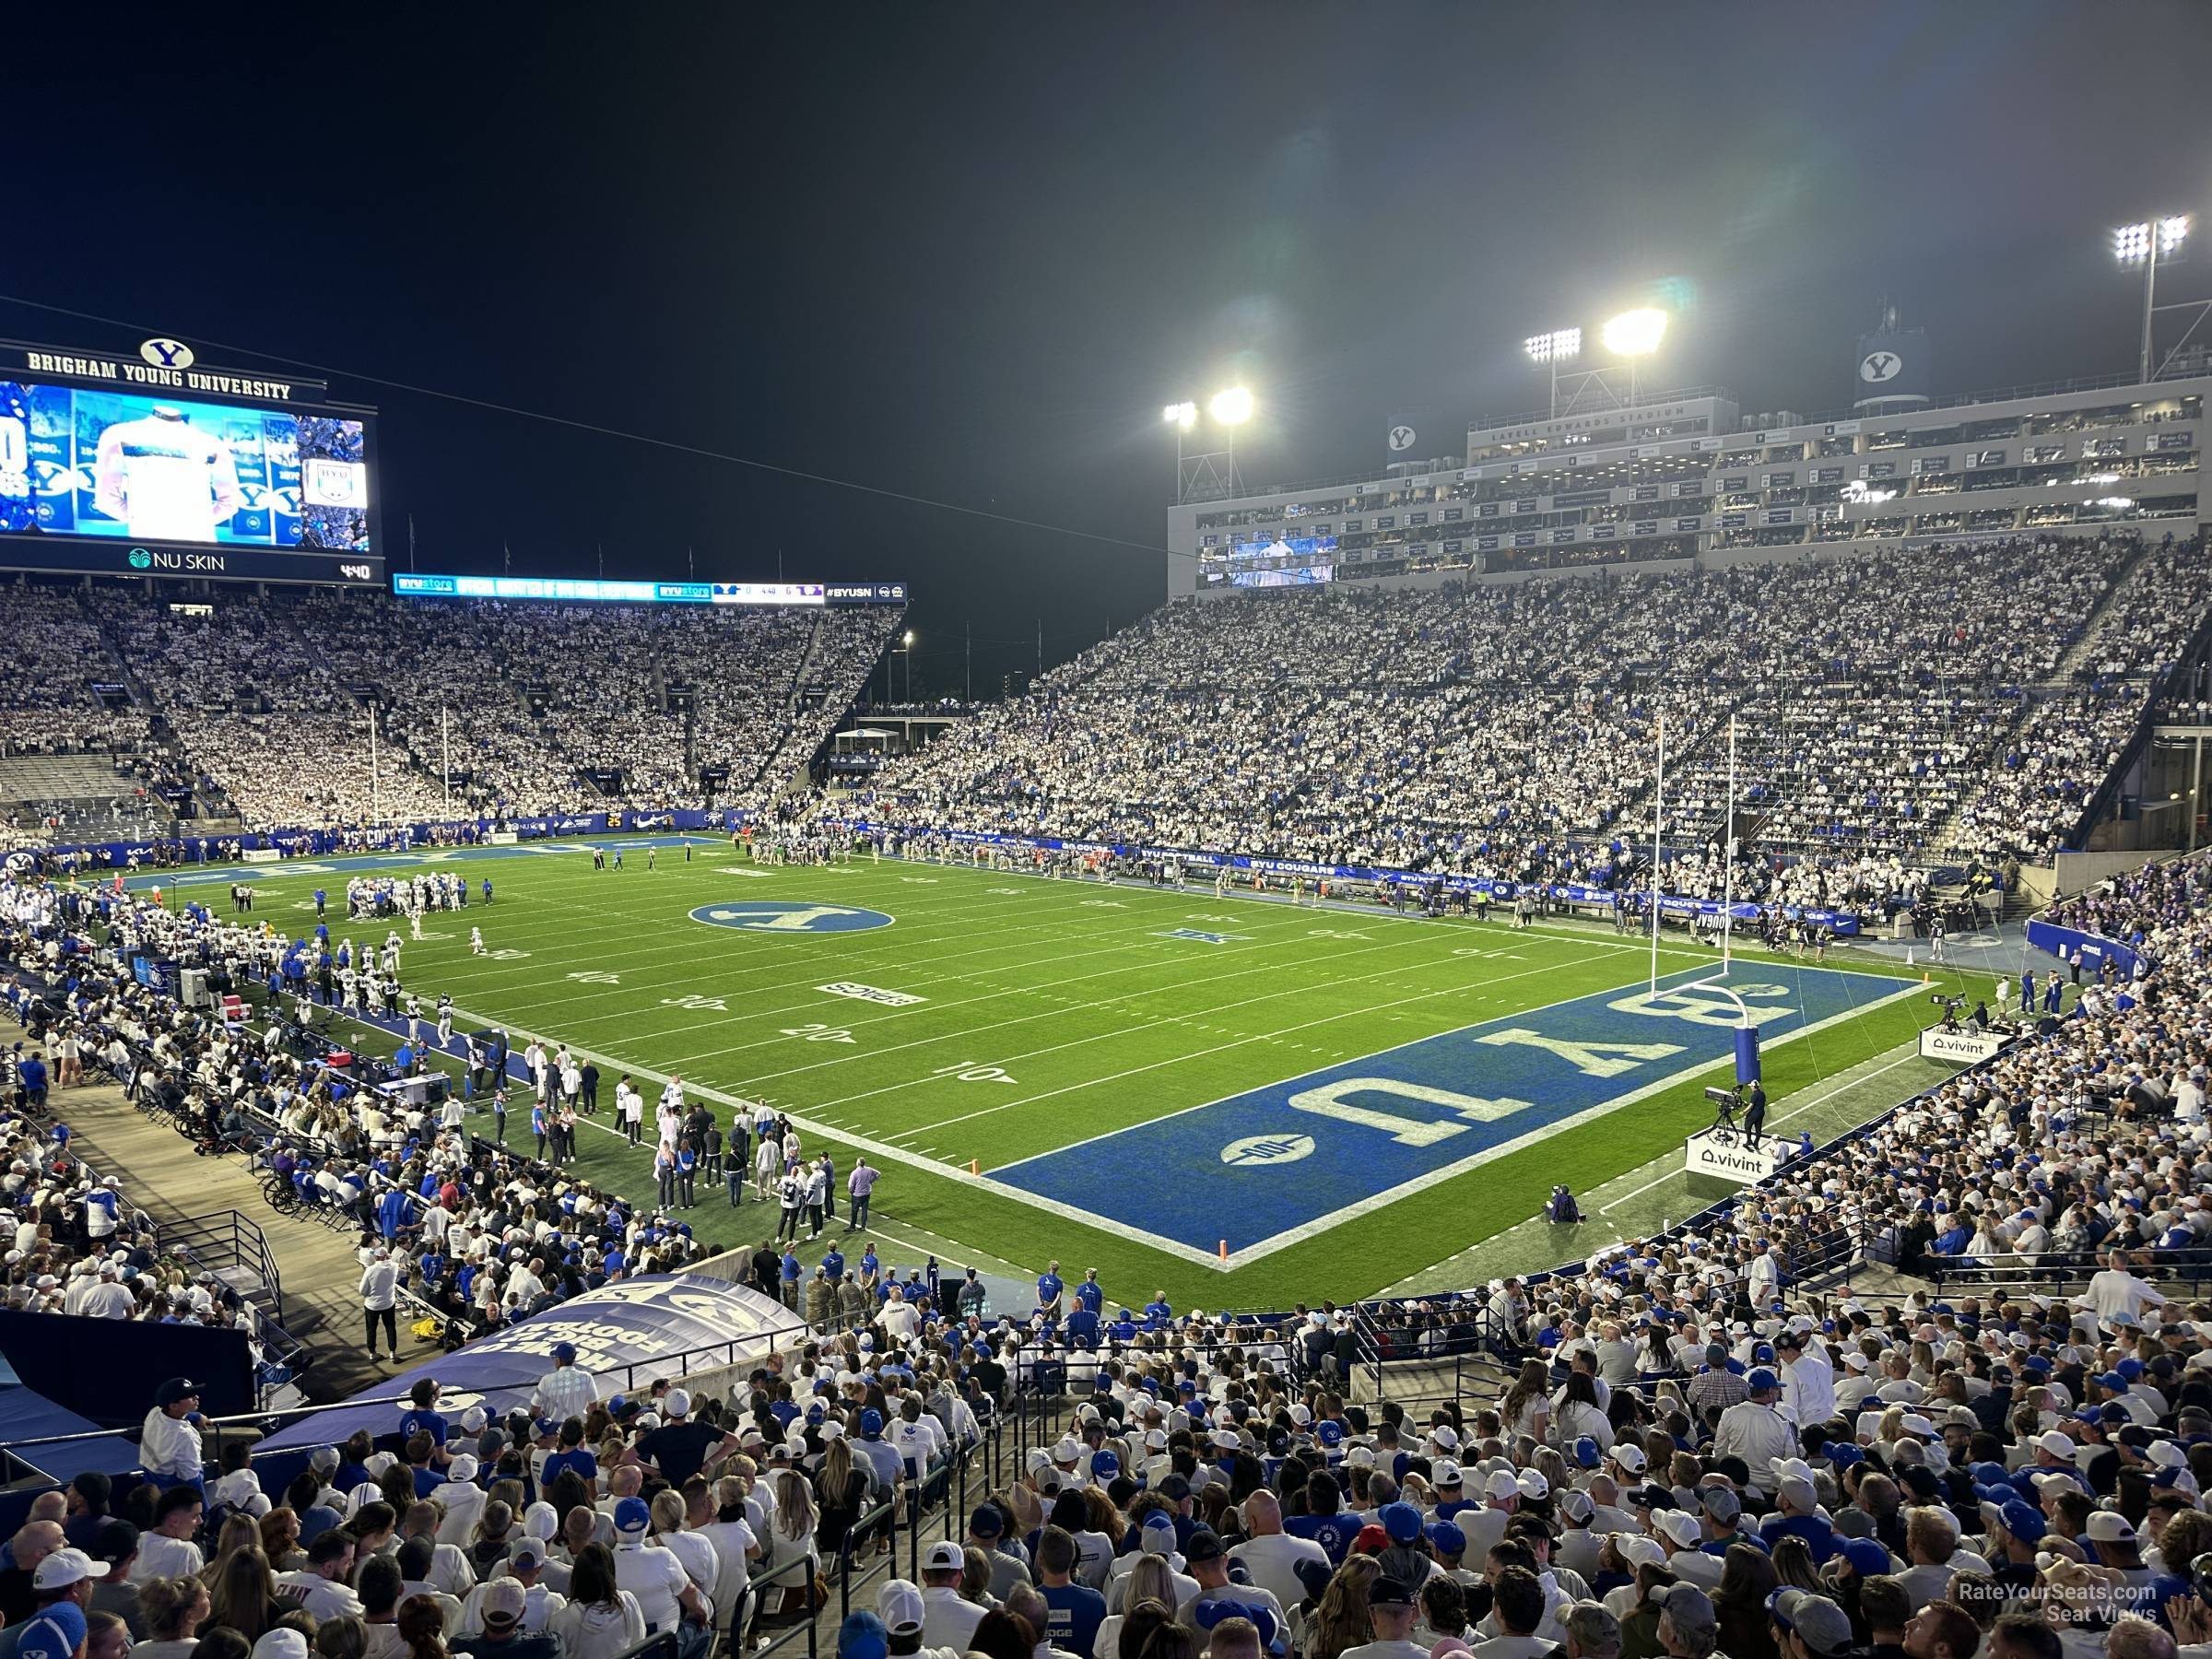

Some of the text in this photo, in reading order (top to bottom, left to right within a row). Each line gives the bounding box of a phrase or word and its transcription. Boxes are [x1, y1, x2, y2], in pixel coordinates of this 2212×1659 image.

[28, 352, 290, 400] BRIGHAM YOUNG UNIVERSITY
[1491, 406, 1685, 441] LAVELL EDWARDS STADIUM
[153, 553, 224, 571] NU SKIN
[340, 563, 371, 580] 4:40
[826, 587, 872, 597] #BYUSN
[607, 817, 621, 826] 25
[1250, 859, 1335, 875] BYU COUGARS
[386, 983, 397, 993] 34
[660, 994, 724, 1010] 30
[779, 1023, 853, 1041] 20
[1947, 1040, 1984, 1055] vivint
[932, 1061, 1006, 1082] 10
[1717, 1153, 1762, 1173] vivint
[546, 1327, 616, 1352] BIG
[900, 1435, 915, 1443] BOX
